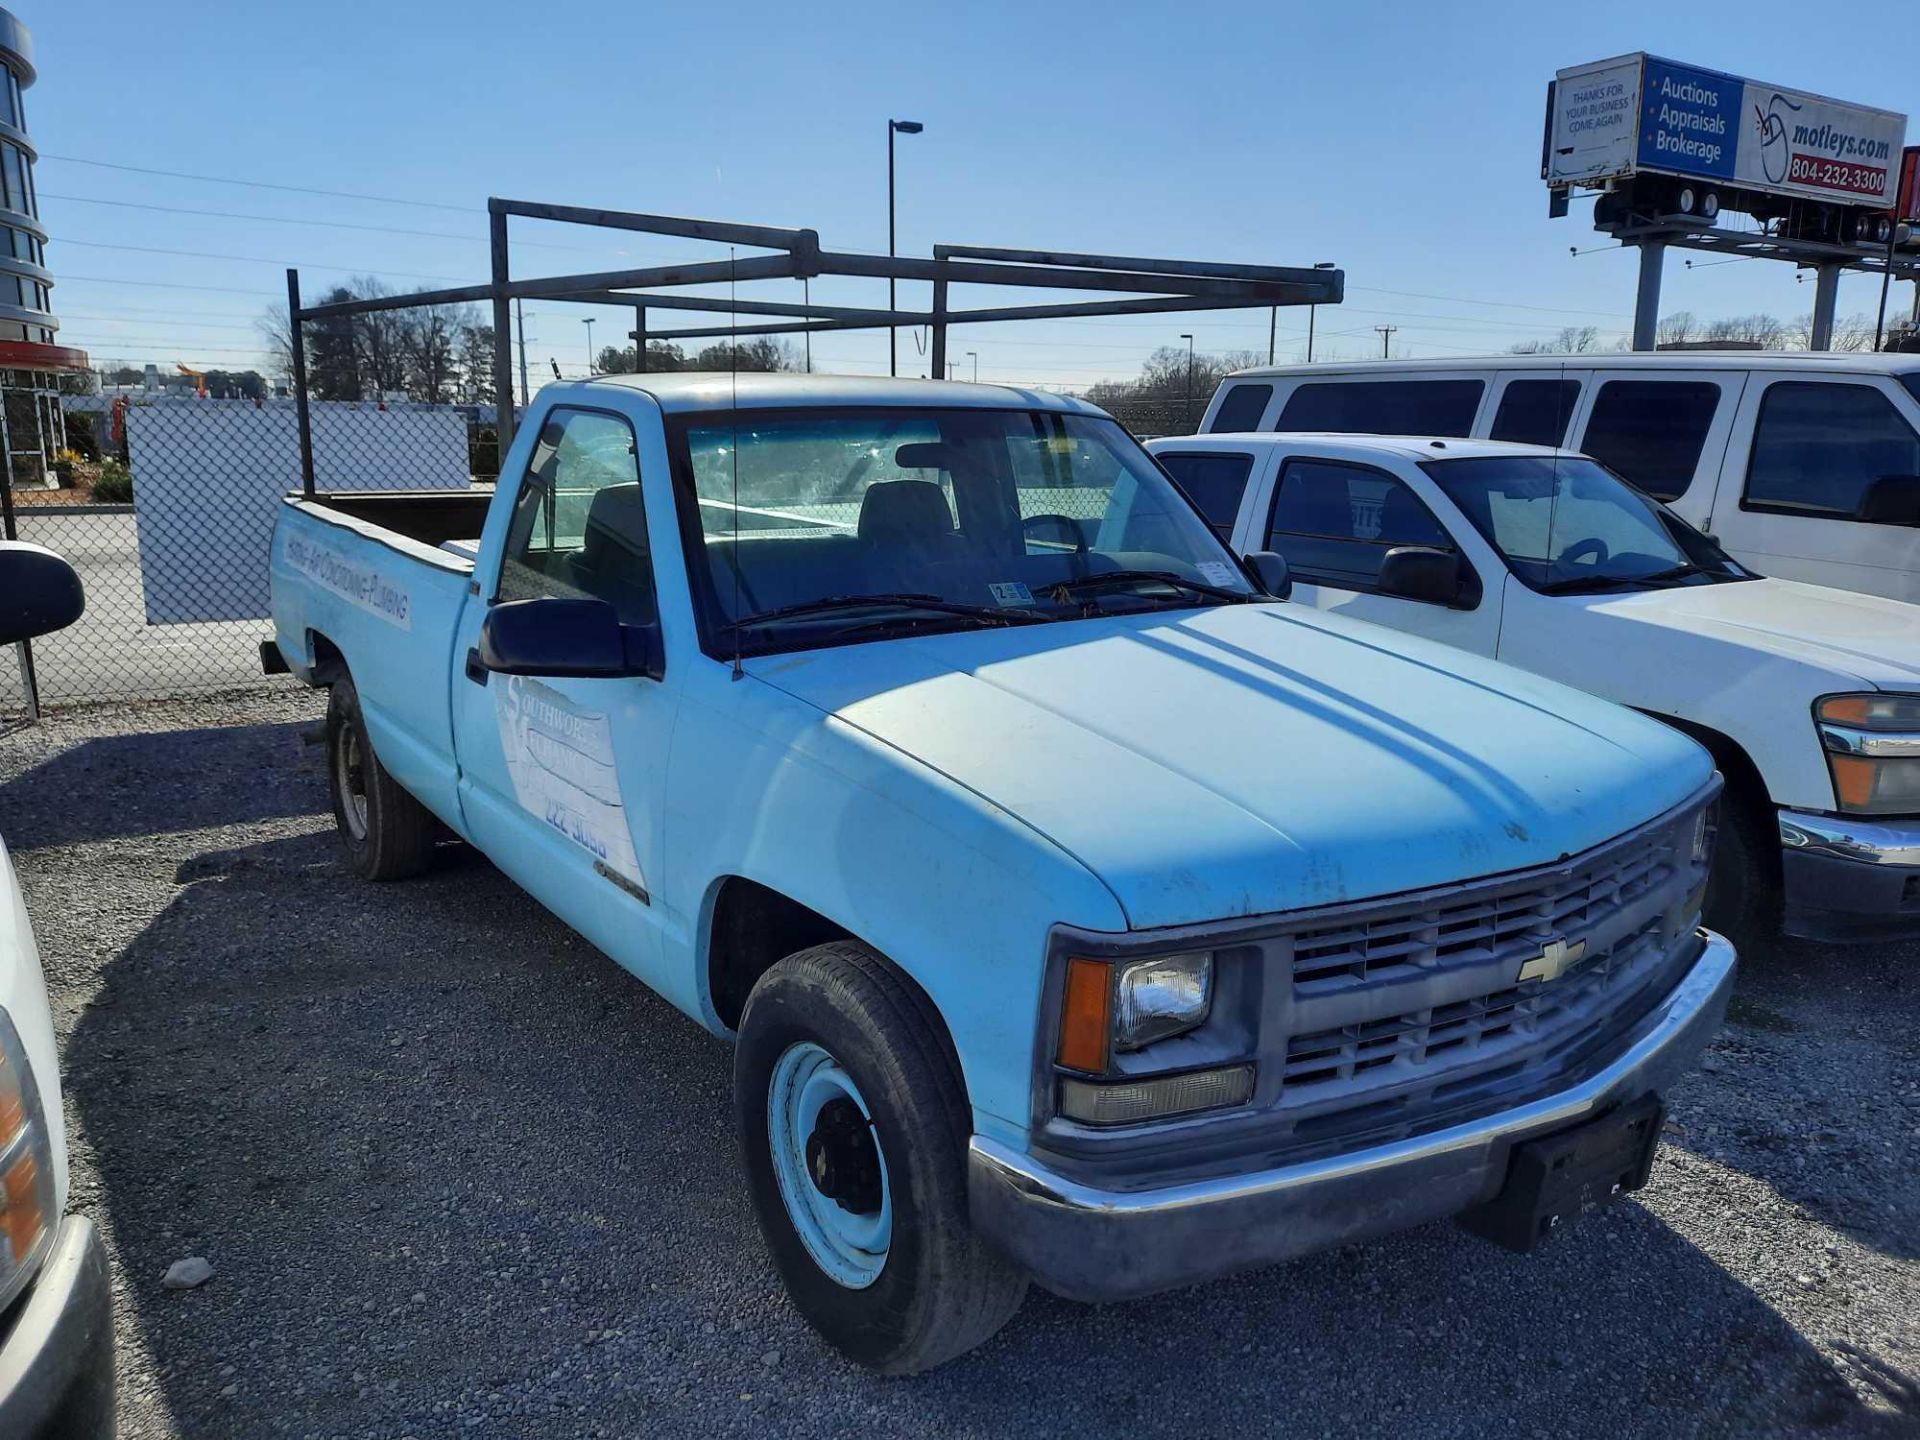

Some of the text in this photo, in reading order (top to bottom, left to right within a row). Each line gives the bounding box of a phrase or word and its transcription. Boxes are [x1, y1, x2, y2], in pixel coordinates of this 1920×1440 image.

[1573, 83, 1624, 103] THANKS FOR
[1661, 76, 1719, 107] Auctions
[1566, 97, 1629, 119] YOUR BUSINESS
[1569, 113, 1623, 133] COME AGAIN
[1658, 103, 1726, 135] Appraisals
[1656, 130, 1721, 164] Brokerage
[1792, 124, 1889, 160] motleys.com
[1792, 158, 1885, 191] 804-232-3300
